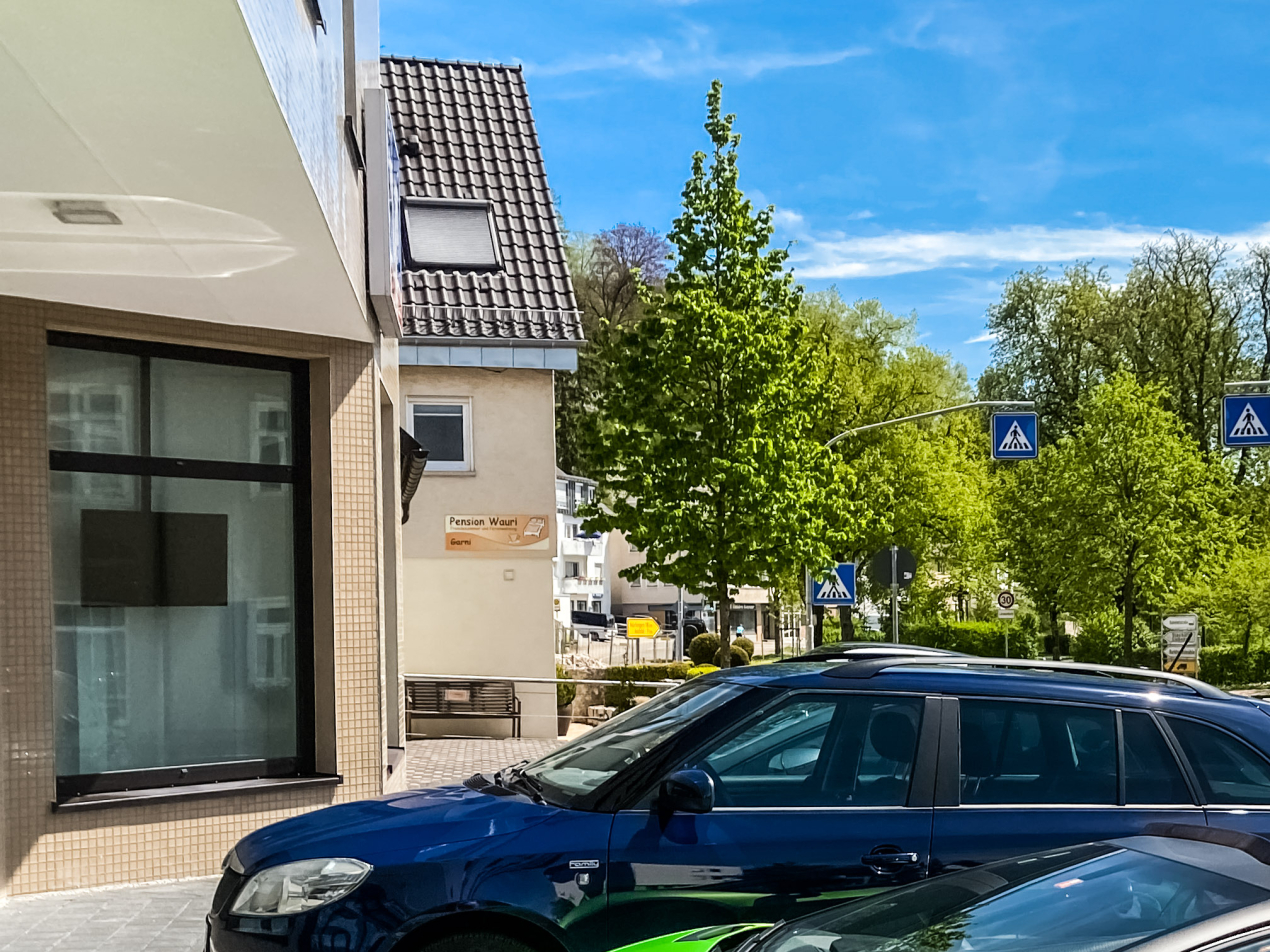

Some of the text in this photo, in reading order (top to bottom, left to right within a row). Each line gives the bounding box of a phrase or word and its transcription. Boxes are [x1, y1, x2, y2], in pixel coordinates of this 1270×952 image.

[449, 517, 518, 526] Pension Wauri
[450, 538, 471, 546] Garni
[1001, 596, 1012, 604] 30
